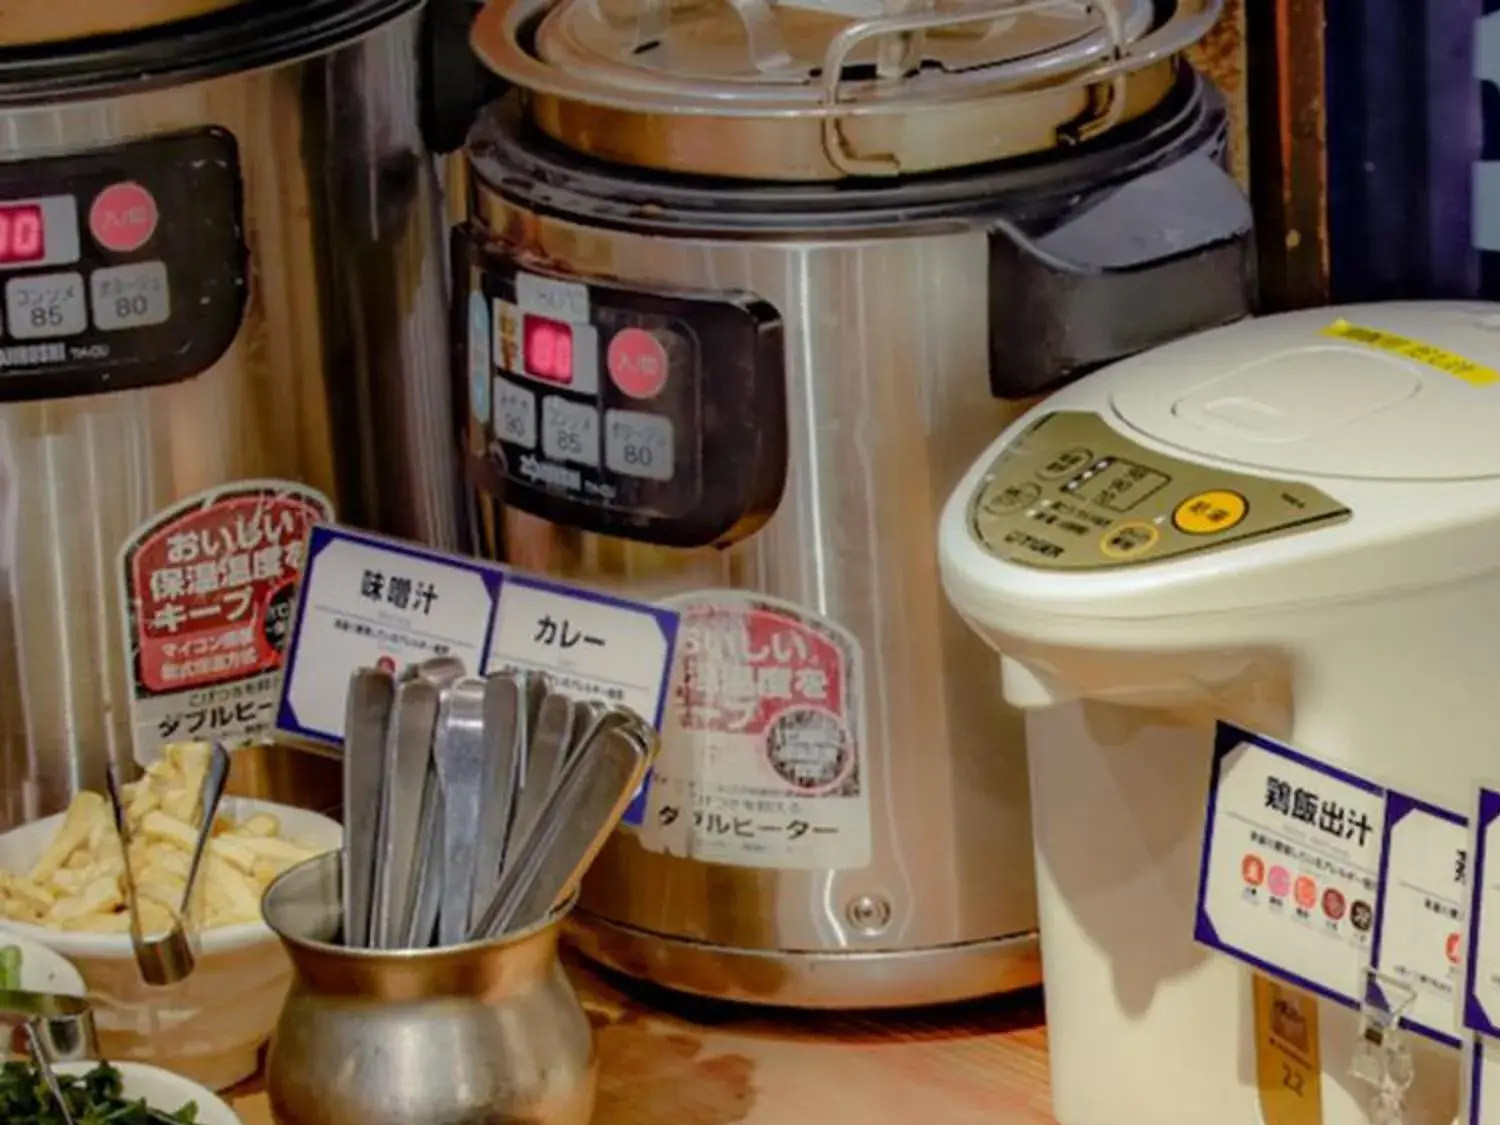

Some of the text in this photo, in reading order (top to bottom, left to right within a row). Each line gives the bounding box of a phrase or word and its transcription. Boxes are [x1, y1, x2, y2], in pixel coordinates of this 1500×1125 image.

[30, 305, 64, 328] 85
[115, 295, 148, 319] 80
[622, 445, 652, 467] 80
[360, 568, 439, 616] 味噌汁
[532, 614, 607, 650] カレー
[1264, 775, 1374, 847] 鶏飯出汁
